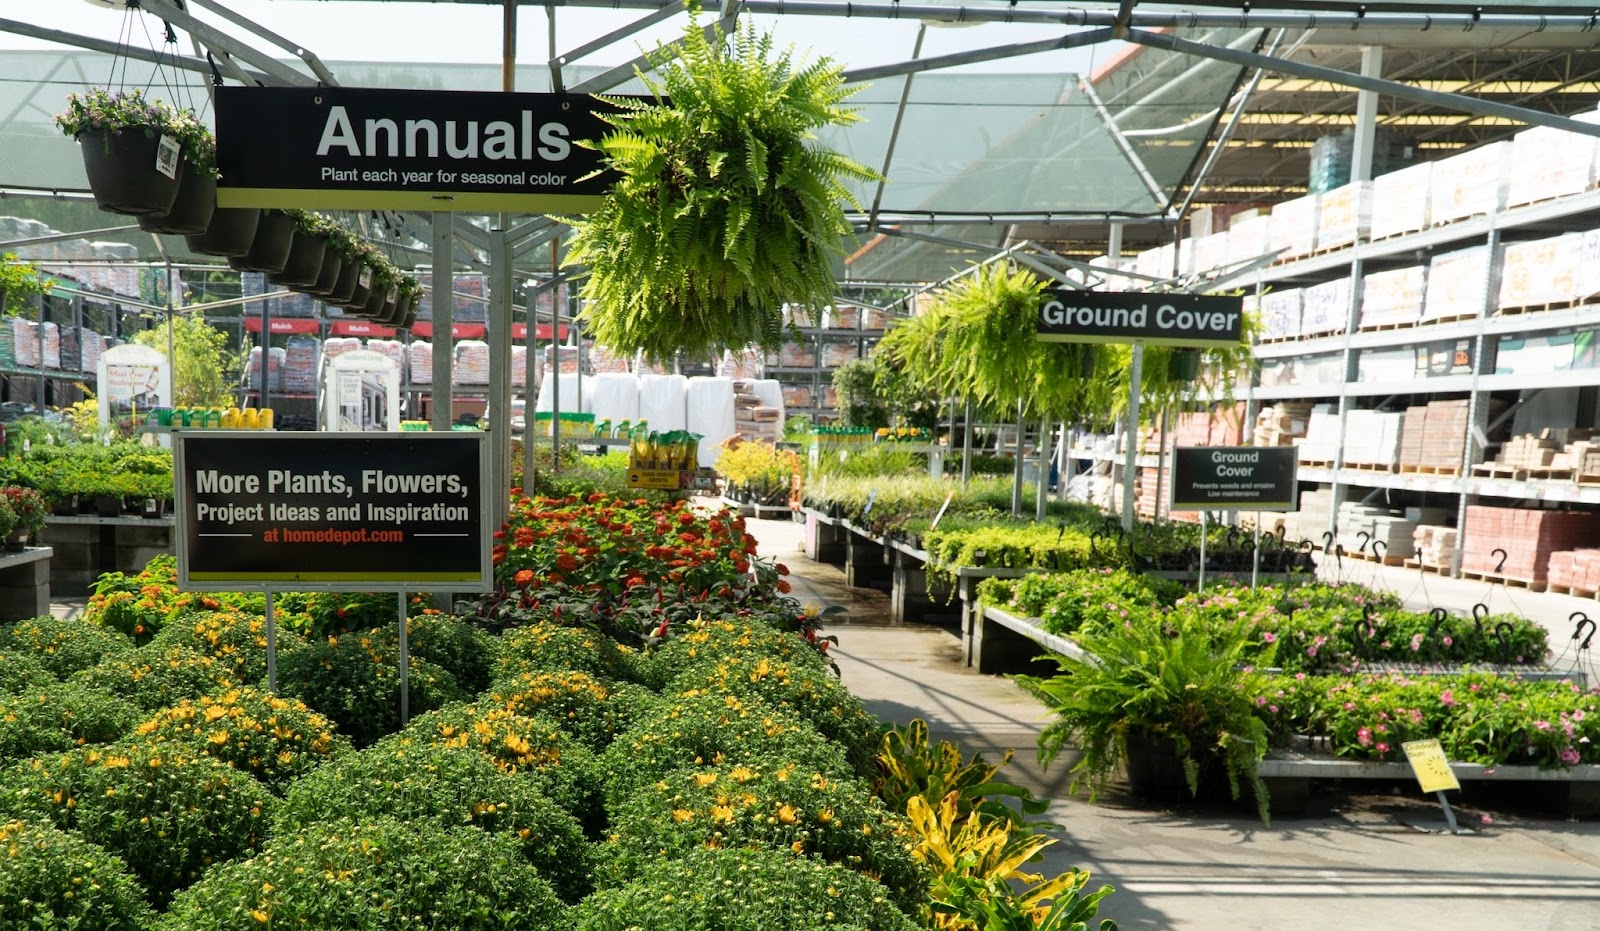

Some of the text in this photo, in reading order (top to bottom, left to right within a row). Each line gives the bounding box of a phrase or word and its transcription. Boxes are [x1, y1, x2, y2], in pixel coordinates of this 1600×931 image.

[317, 106, 571, 161] Annuals
[321, 168, 567, 186] Plant each year for seasonal color
[1042, 300, 1147, 328] Ground
[1156, 304, 1238, 332] Cover
[1211, 451, 1259, 463] Ground
[1216, 465, 1254, 477] Cover
[196, 469, 468, 498] More Plants, Flowers,
[197, 502, 469, 525] Project Ideas and Inspiration
[263, 527, 403, 545] at homedepot.com
